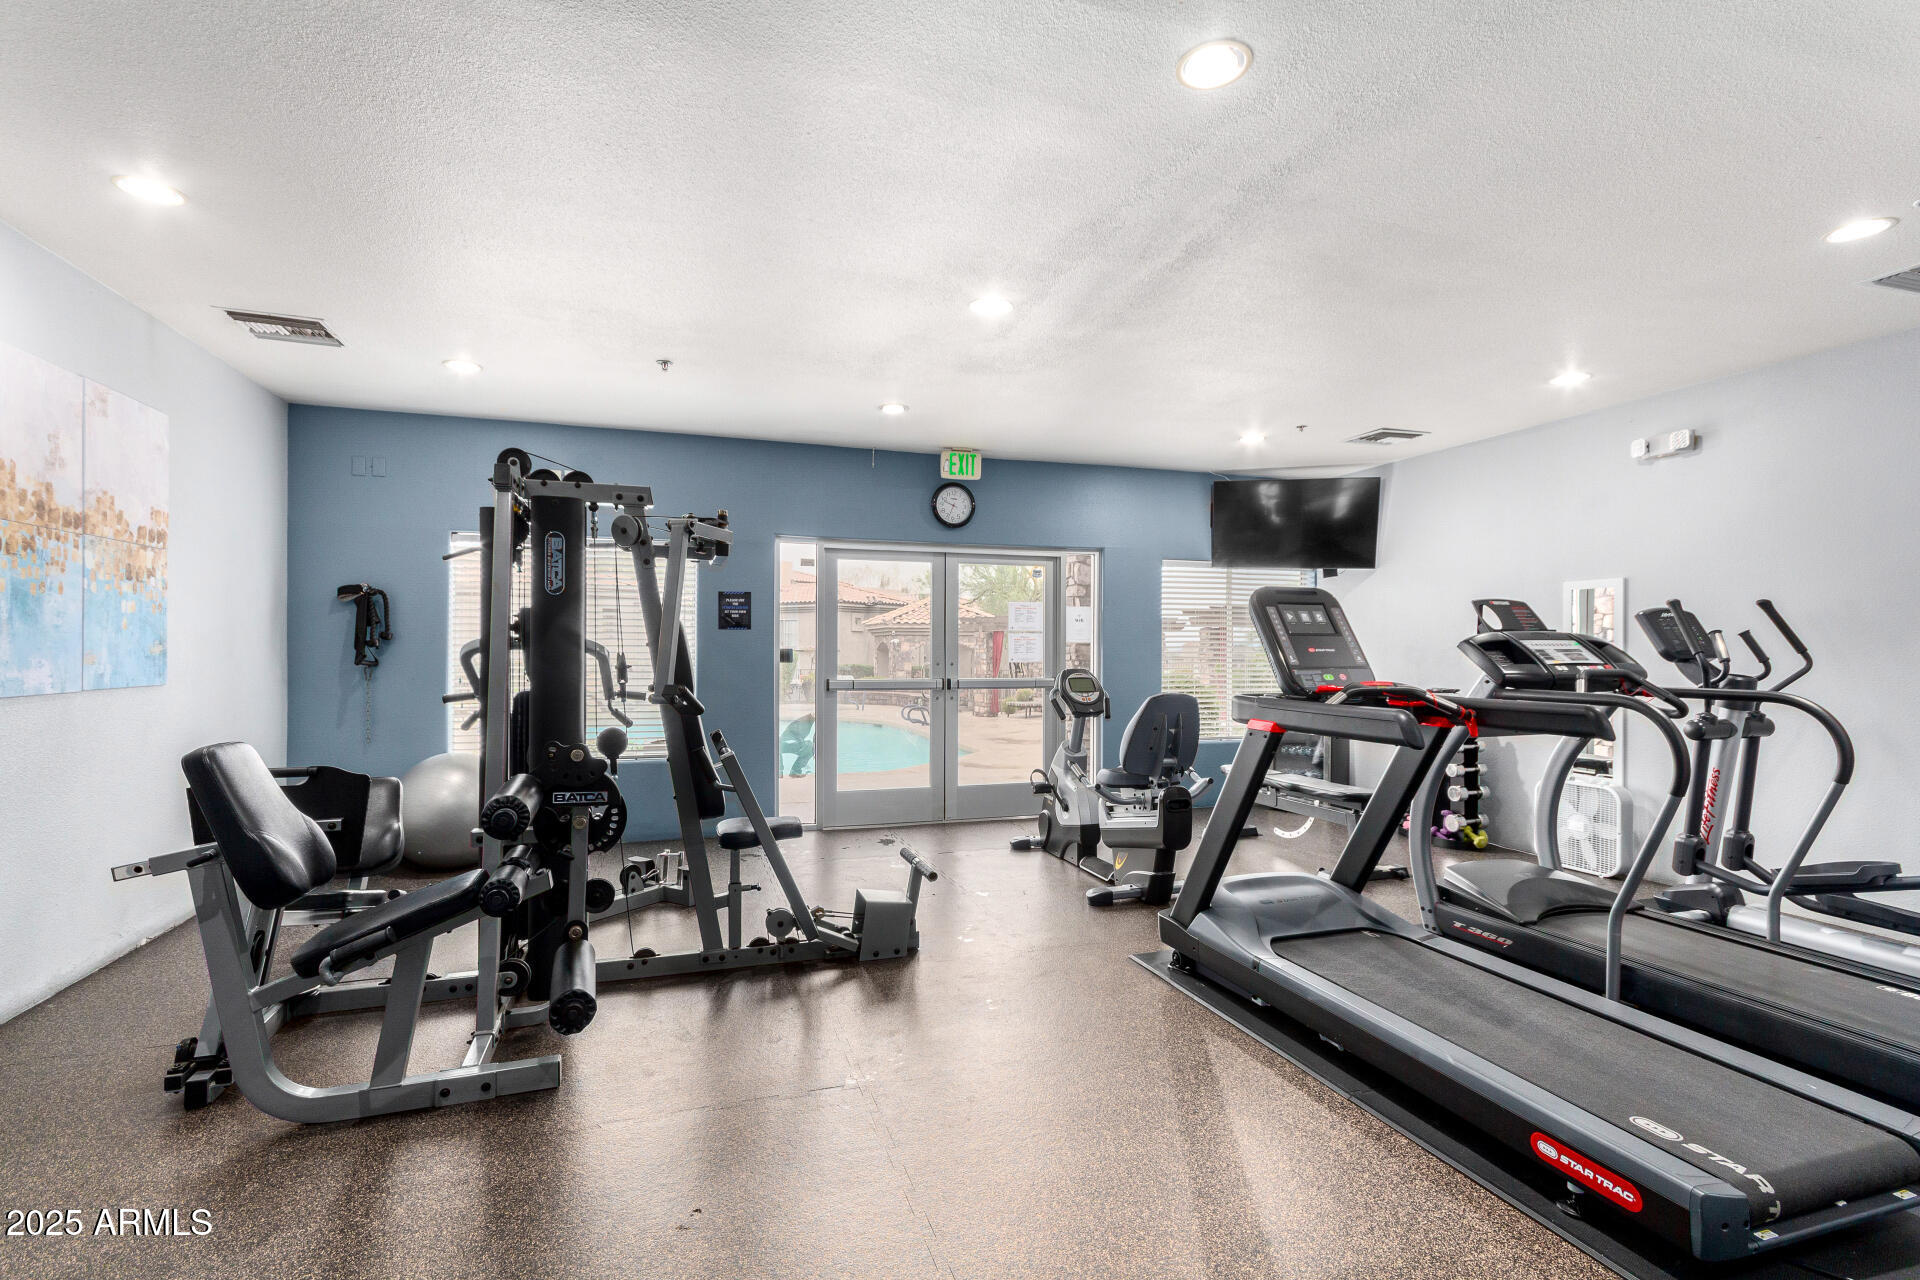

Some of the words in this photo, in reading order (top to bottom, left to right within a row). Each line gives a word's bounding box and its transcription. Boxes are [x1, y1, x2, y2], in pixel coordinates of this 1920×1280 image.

[949, 452, 977, 477] EXIT
[551, 537, 563, 591] BATCA
[553, 791, 608, 803] BATCA
[1559, 1154, 1595, 1180] STAR
[1595, 1174, 1635, 1203] TRAC
[1681, 1143, 1776, 1194] STAR
